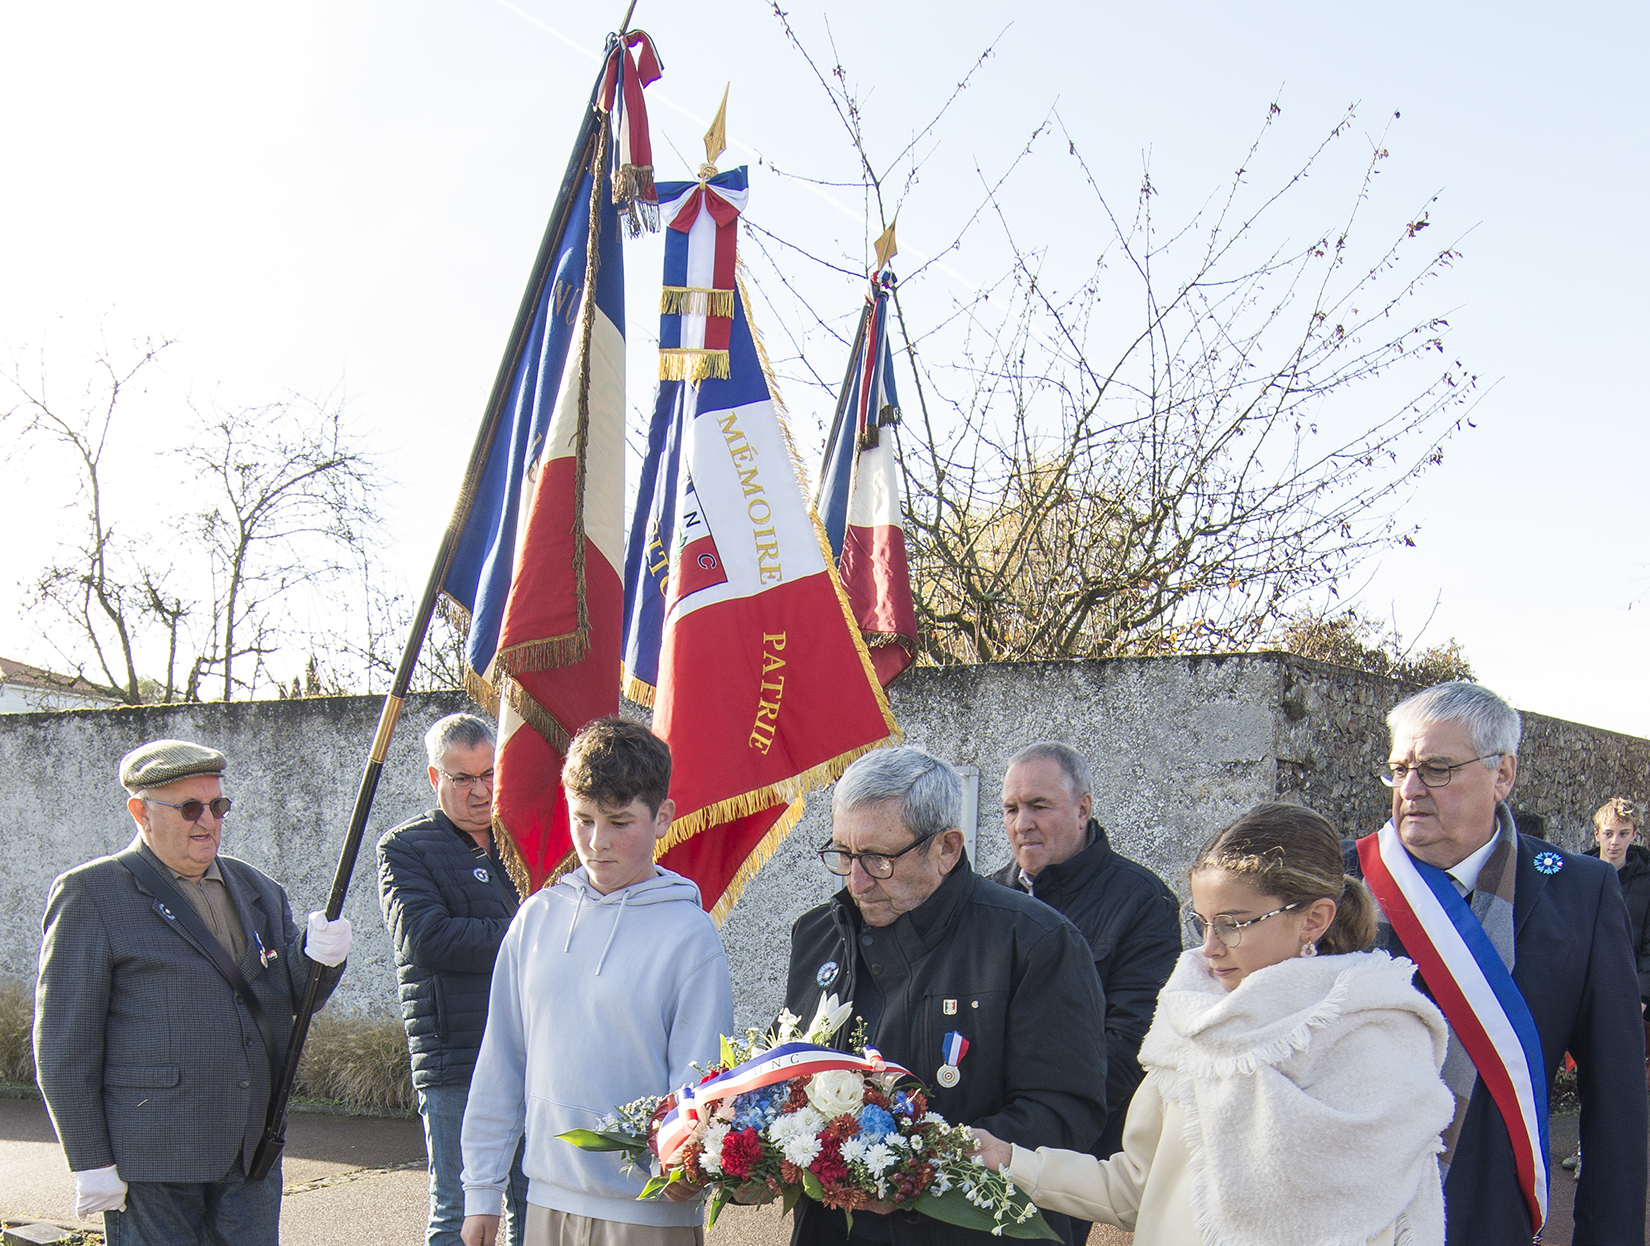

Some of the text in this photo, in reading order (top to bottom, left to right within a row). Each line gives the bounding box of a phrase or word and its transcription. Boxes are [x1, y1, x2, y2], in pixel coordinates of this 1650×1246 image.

[716, 411, 783, 586] MÉMOIRE
[748, 630, 787, 756] PATRIE
[754, 1053, 800, 1077] UNC
